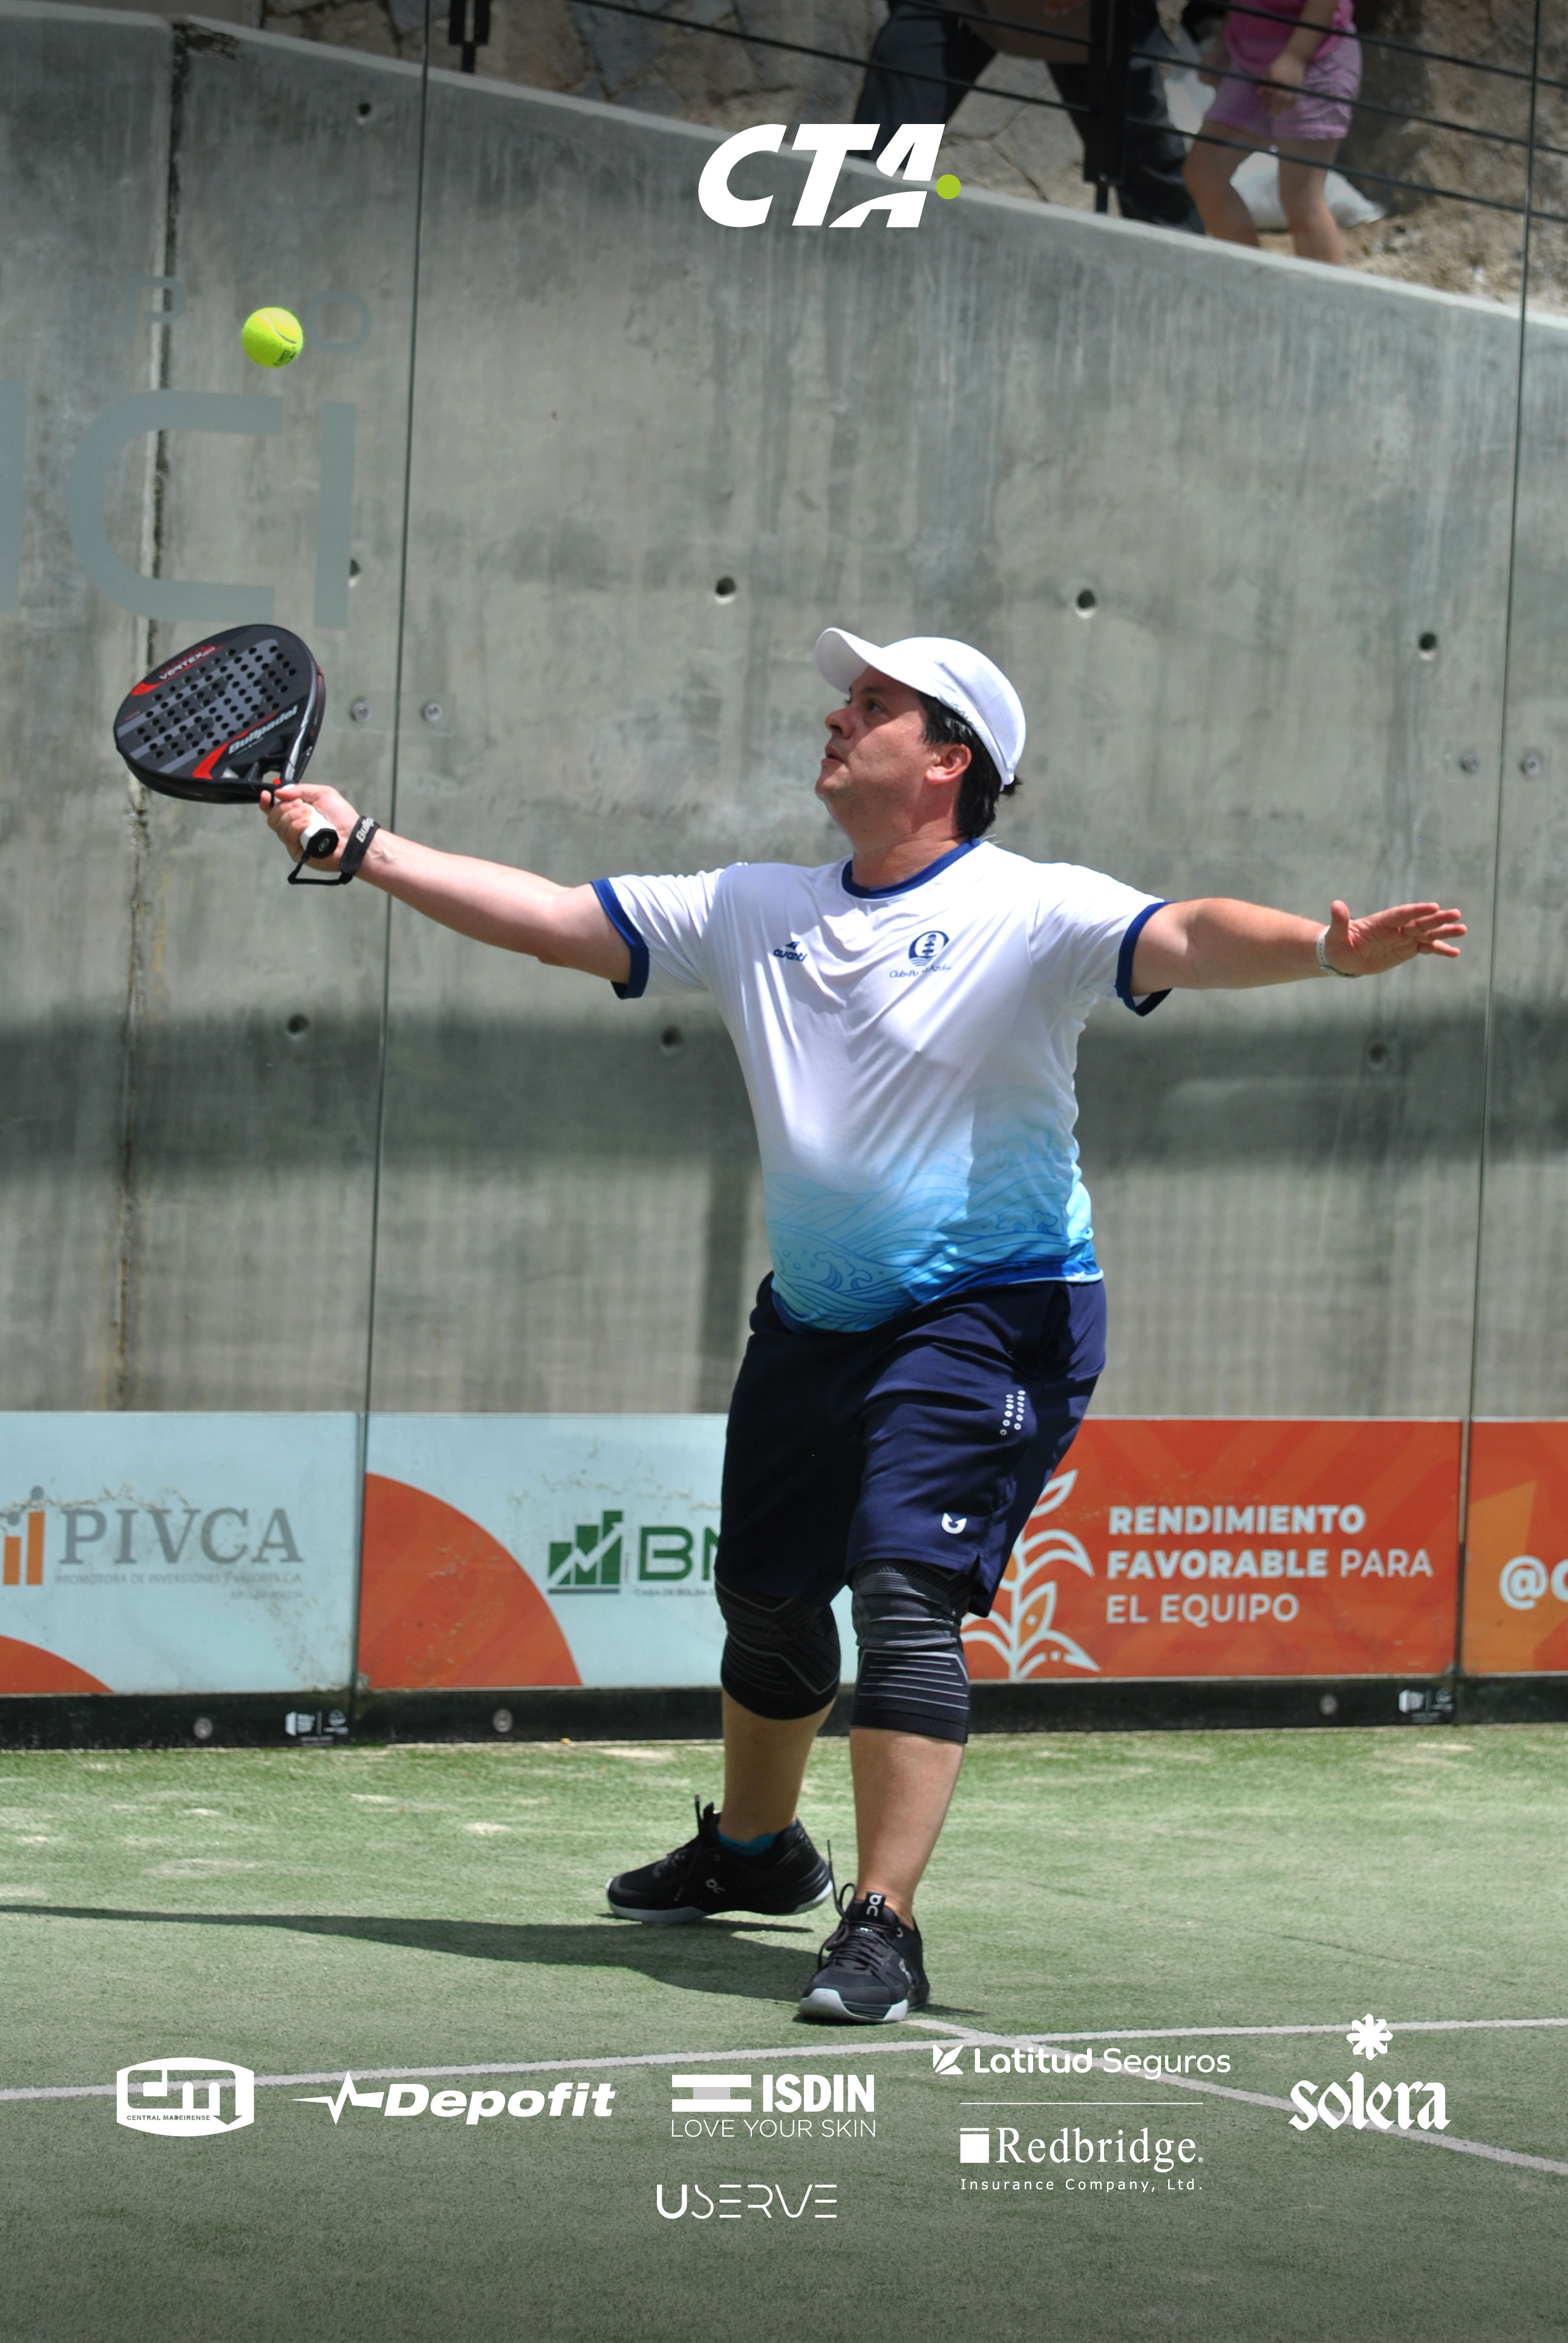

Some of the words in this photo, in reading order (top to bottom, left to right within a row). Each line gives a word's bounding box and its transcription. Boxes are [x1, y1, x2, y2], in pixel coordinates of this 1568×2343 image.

[227, 704, 298, 755] Bullpadel
[59, 1507, 303, 1565] PIVCA
[1109, 1504, 1366, 1535] RENDIMIENTO
[1106, 1548, 1328, 1579] FAVORABLE
[1341, 1548, 1433, 1578] PARA
[1106, 1594, 1149, 1624] EL
[1160, 1593, 1299, 1627] EQUIPO
